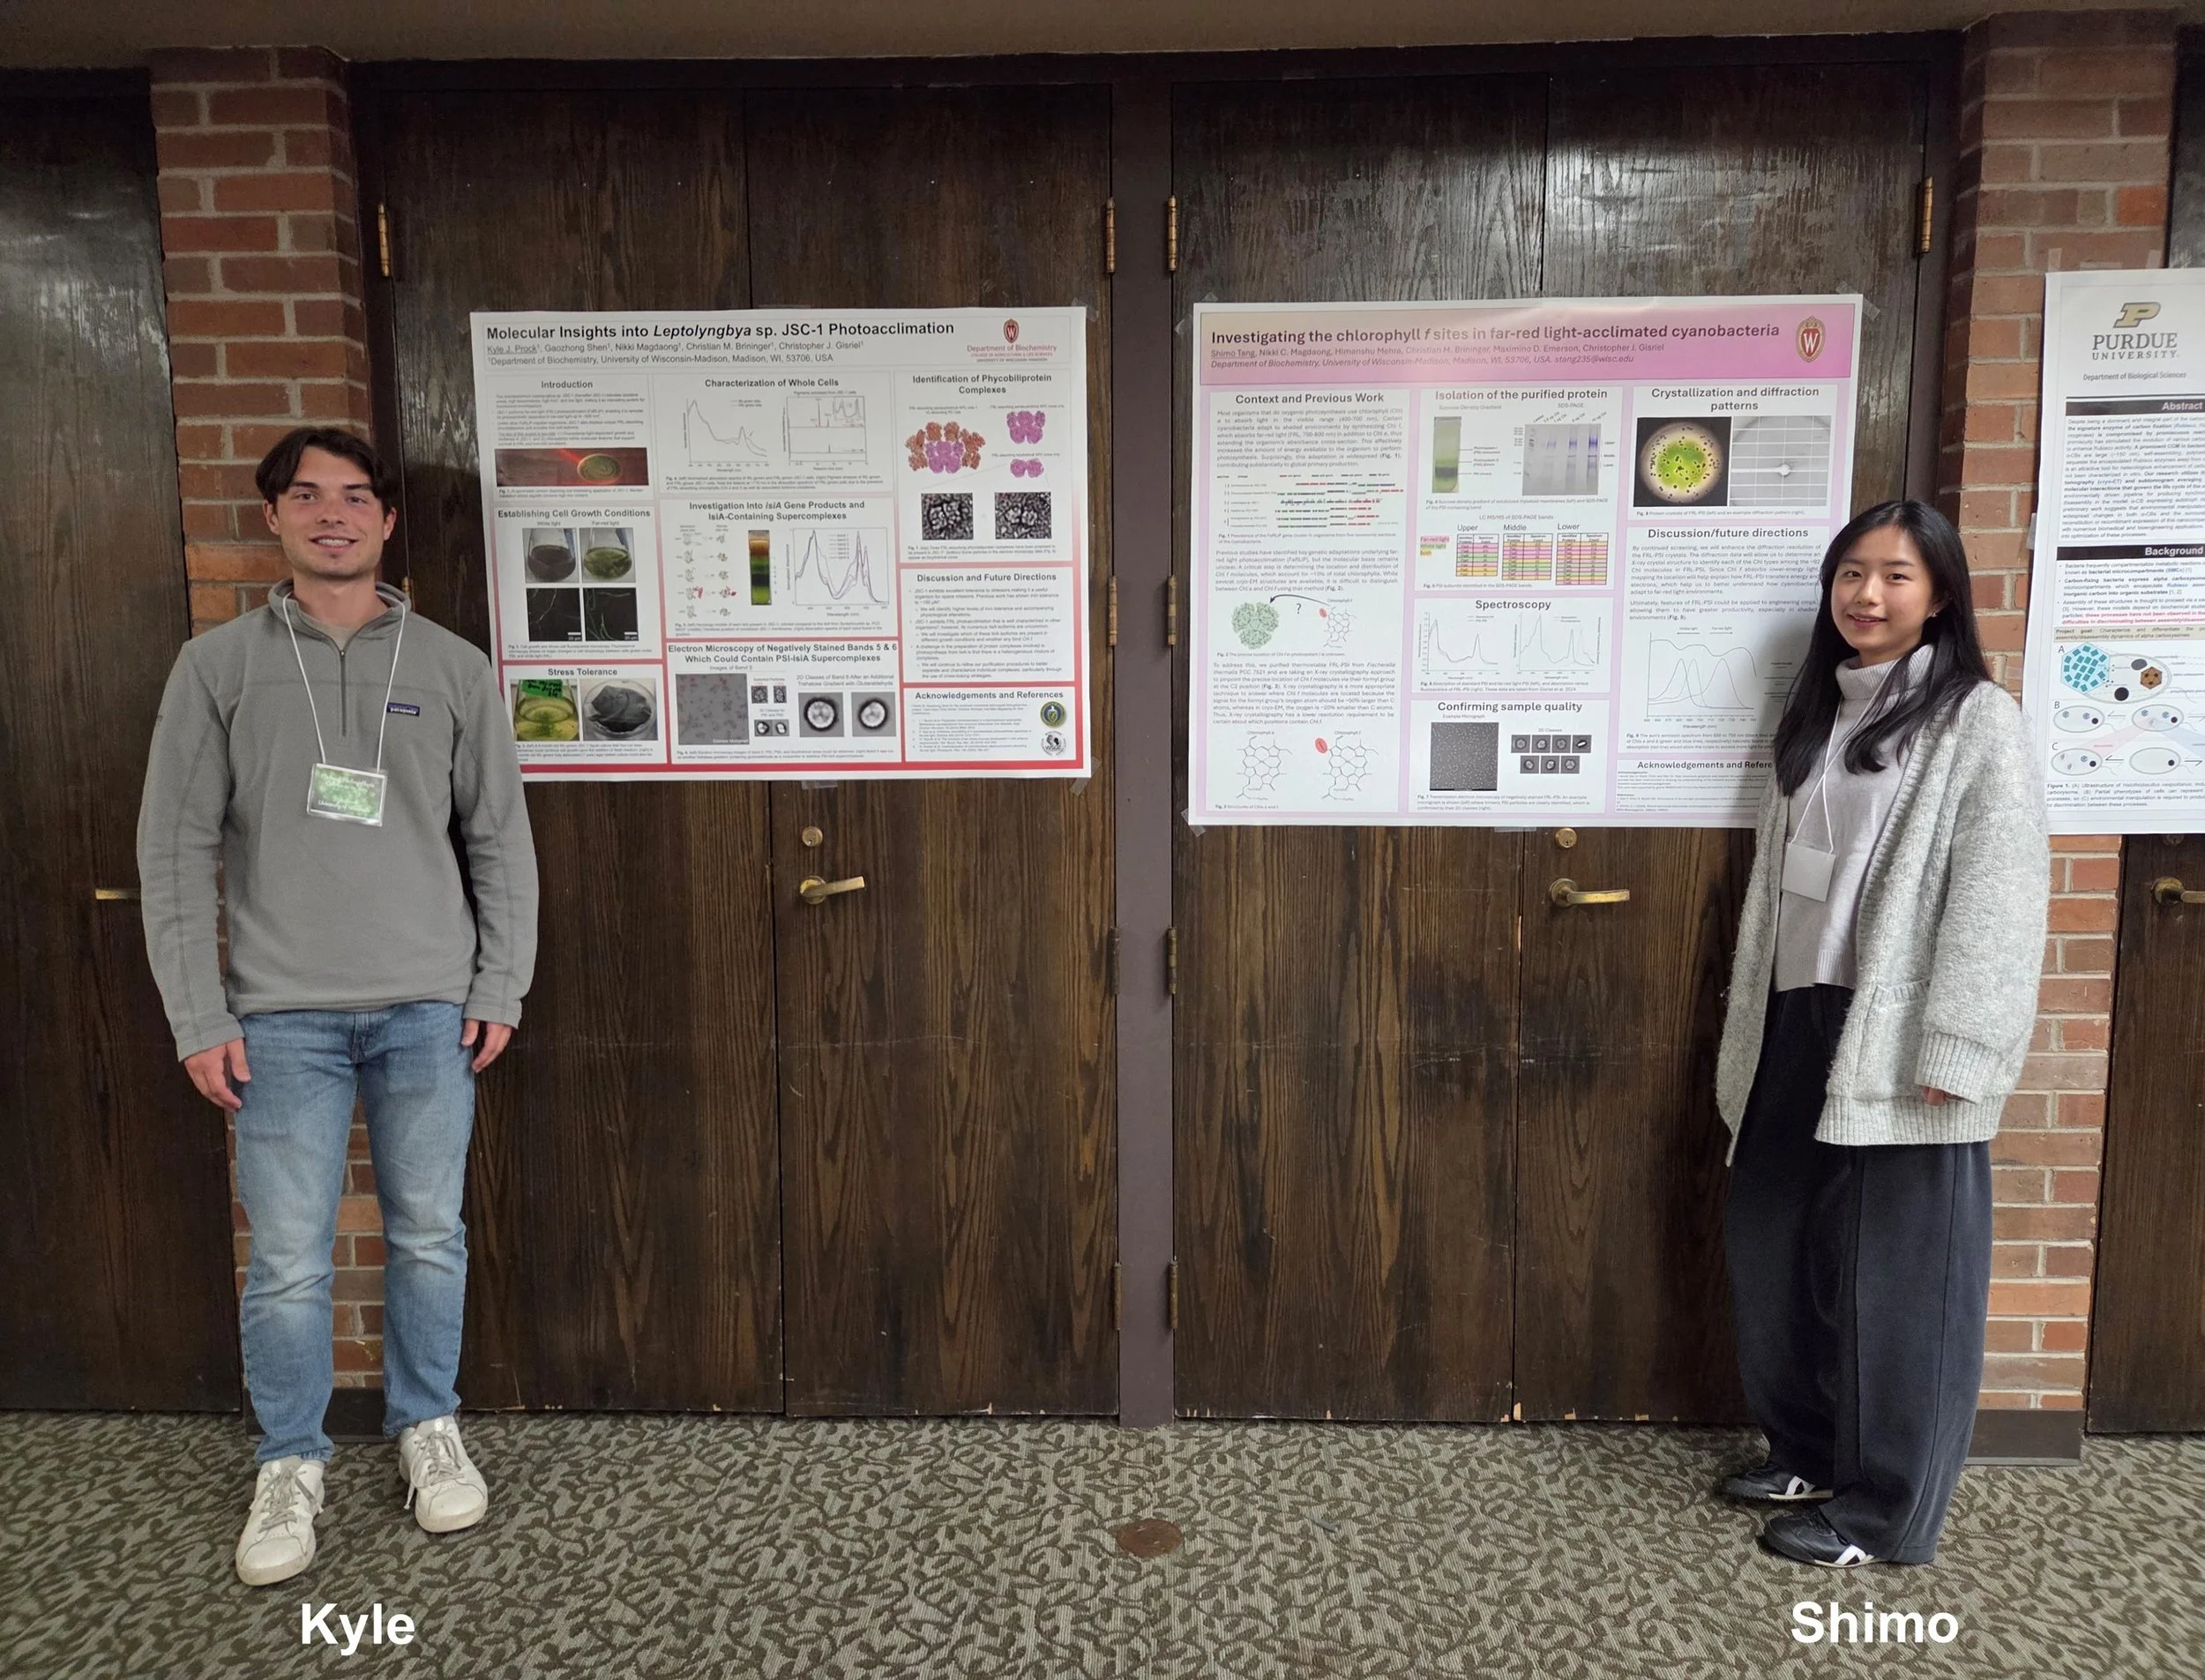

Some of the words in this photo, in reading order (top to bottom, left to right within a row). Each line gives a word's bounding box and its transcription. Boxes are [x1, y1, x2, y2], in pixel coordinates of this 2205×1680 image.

[2113, 302, 2162, 328] P
[487, 327, 555, 340] Molecular
[560, 326, 617, 340] Insights
[622, 325, 648, 337] into
[654, 325, 751, 340] Leptolyngbya
[756, 327, 777, 339] sp.
[782, 323, 823, 336] JSC-1
[829, 322, 954, 335] Photoacclimation
[1212, 331, 1305, 345] Investigating
[1309, 330, 1333, 342] the
[1336, 329, 1421, 343] chlorophyll
[1424, 328, 1432, 340] f
[1433, 328, 1469, 340] sites
[1473, 327, 1486, 340] in
[1490, 325, 1539, 340] far-red
[1544, 325, 1668, 340] light-acclimated
[1671, 324, 1780, 339] cyanobacteria
[1805, 332, 1819, 350] W
[2092, 332, 2178, 350] PURDUE
[488, 344, 504, 355] Kyle
[506, 344, 512, 353] J.
[544, 343, 585, 354] Gaozhong
[686, 342, 721, 351] Christian
[779, 341, 824, 351] Christopher
[967, 345, 1005, 354] Department
[1015, 344, 1058, 353] Biochemistry
[1211, 349, 1236, 358] Shimo
[1237, 348, 1257, 359] Tang,
[1290, 347, 1333, 358] Magdaong,
[1334, 347, 1375, 356] Himanshu
[1406, 346, 1441, 355] Christian
[1493, 344, 1532, 353] Maximino
[1533, 344, 1542, 353] D.
[1544, 343, 1581, 354] Emerson,
[1582, 342, 1629, 354] Christopher
[1630, 343, 1637, 352] J.
[1639, 342, 1664, 352] Gisriel
[548, 355, 599, 365] Biochemistry,
[601, 355, 639, 365] University
[651, 354, 730, 362] Wisconsin-Madison,
[733, 354, 769, 362] Madison,
[786, 354, 813, 363] 53706,
[815, 353, 833, 362] USA
[2092, 350, 2178, 360] UNIVERSITY
[1211, 359, 1259, 370] Department
[1261, 359, 1267, 368] of
[1268, 358, 1320, 369] Biochemistry,
[1322, 357, 1361, 368] University
[1362, 357, 1371, 366] of
[1372, 356, 1451, 367] Wisconsin-Madison,
[1453, 356, 1489, 366] Madison,
[778, 378, 787, 387] of
[913, 375, 970, 384] Identification
[972, 375, 980, 384] of
[982, 374, 1052, 384] Phycobiliprotein
[959, 386, 1006, 395] Complexes
[1436, 391, 1484, 400] Isolation
[1487, 391, 1498, 399] of
[1500, 391, 1519, 399] the
[1521, 390, 1565, 400] purified
[1567, 390, 1608, 399] protein
[1651, 389, 1733, 399] Crystallization
[1737, 388, 1758, 397] and
[1760, 387, 1820, 397] diffraction
[1236, 394, 1279, 404] Context
[1282, 394, 1302, 403] and
[1305, 394, 1352, 403] Previous
[1355, 393, 1384, 402] Work
[1710, 402, 1759, 412] patterns
[2162, 401, 2202, 411] Abstract
[689, 502, 744, 511] Investigation
[498, 510, 550, 519] Establishing
[708, 512, 774, 521] IsiA-Containing
[776, 512, 847, 521] Supercomplexes
[1648, 528, 1750, 539] Discussion/future
[1753, 527, 1809, 537] directions
[2145, 547, 2203, 557] Background
[1476, 601, 1551, 610] Spectroscopy
[706, 645, 754, 653] Microscopy
[767, 643, 811, 653] Negatively
[813, 643, 844, 652] Stained
[811, 654, 880, 663] Supercomplexes
[916, 691, 997, 700] Acknowledgements
[1438, 702, 1499, 713] Confirming
[1501, 702, 1542, 713] sample
[1544, 702, 1582, 713] quality
